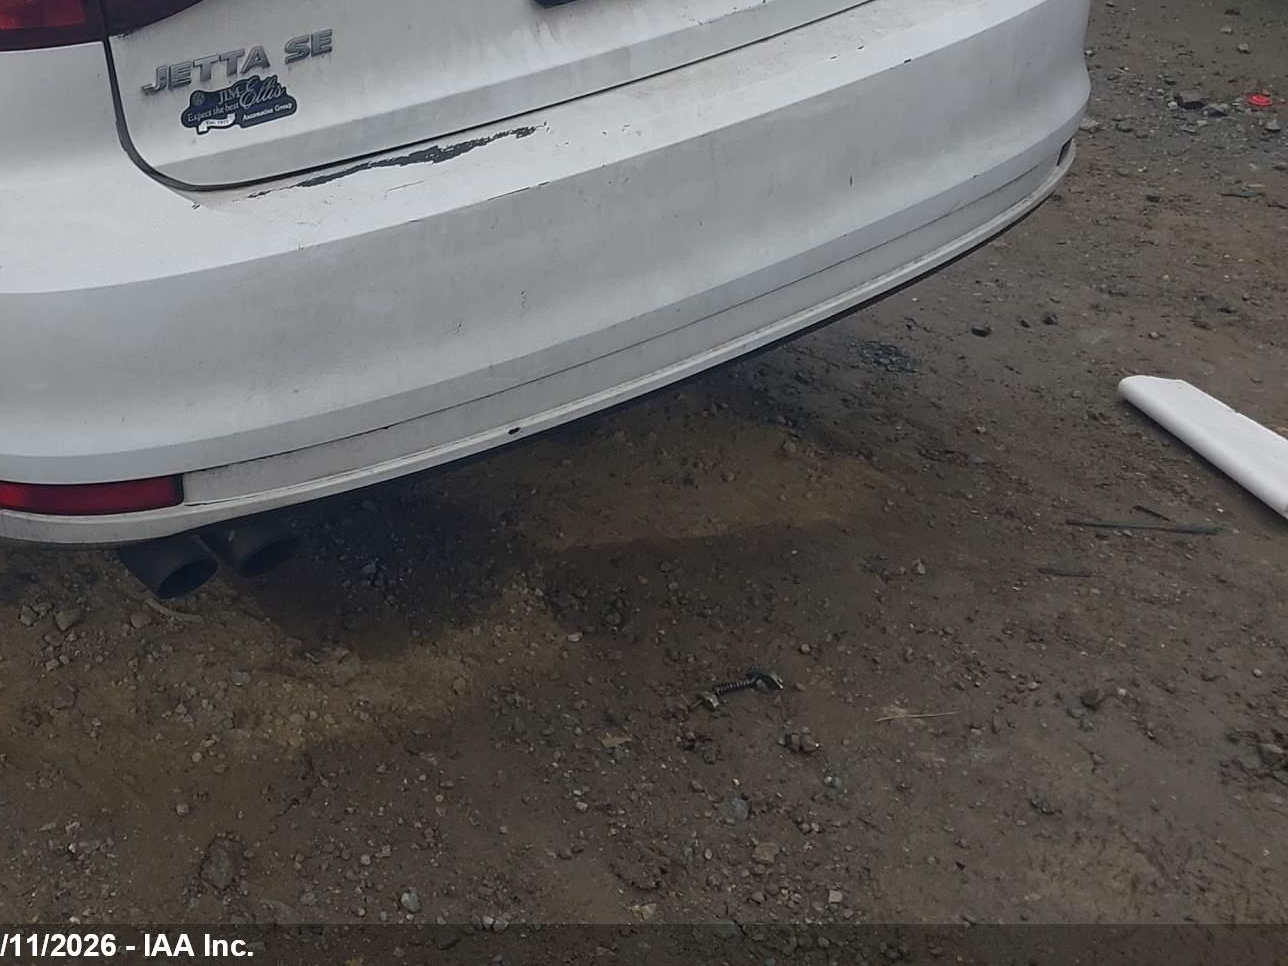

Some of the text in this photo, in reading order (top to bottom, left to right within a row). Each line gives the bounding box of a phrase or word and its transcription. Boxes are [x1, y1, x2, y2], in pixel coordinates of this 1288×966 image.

[140, 29, 333, 95] JETTA SE
[218, 76, 283, 110] JIM Ellis
